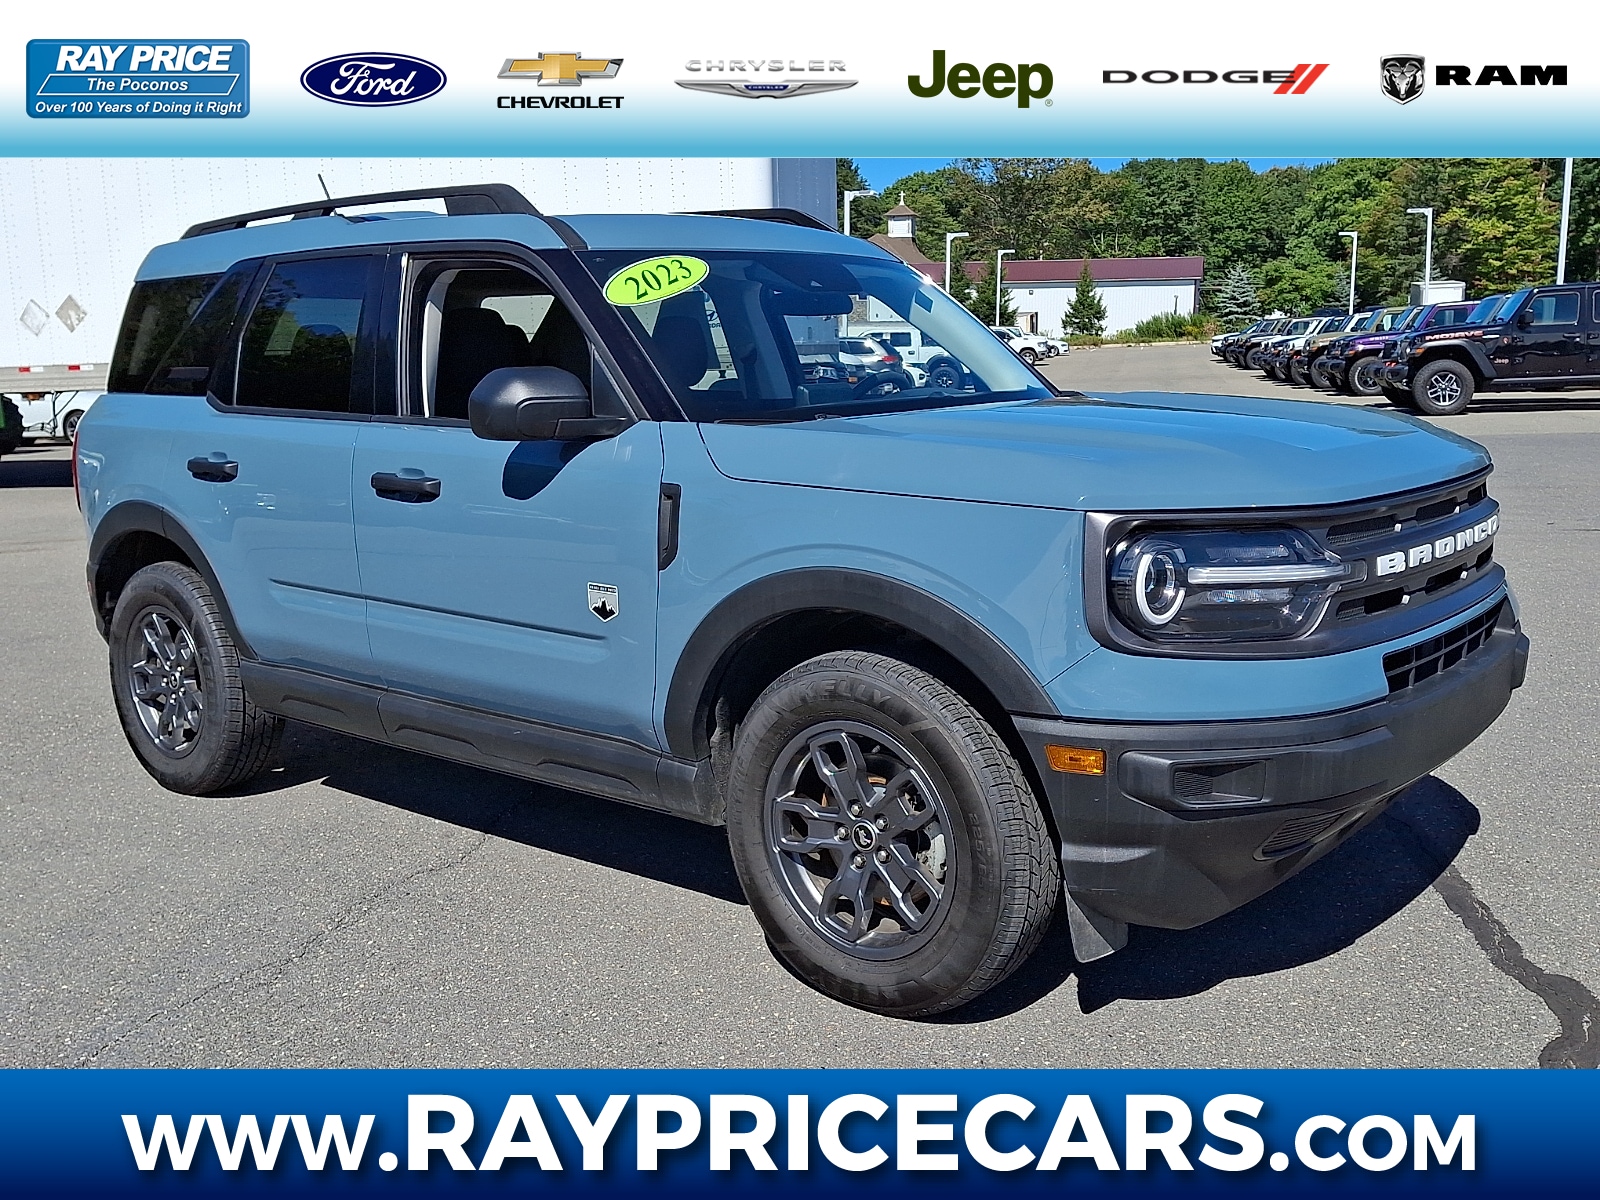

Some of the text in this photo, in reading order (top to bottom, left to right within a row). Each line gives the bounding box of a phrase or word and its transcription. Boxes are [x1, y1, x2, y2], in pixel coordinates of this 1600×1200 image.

[624, 259, 692, 301] 2023
[1425, 331, 1484, 341] MOJAVE
[1376, 514, 1499, 577] BRONCO
[802, 679, 892, 704] KELLY
